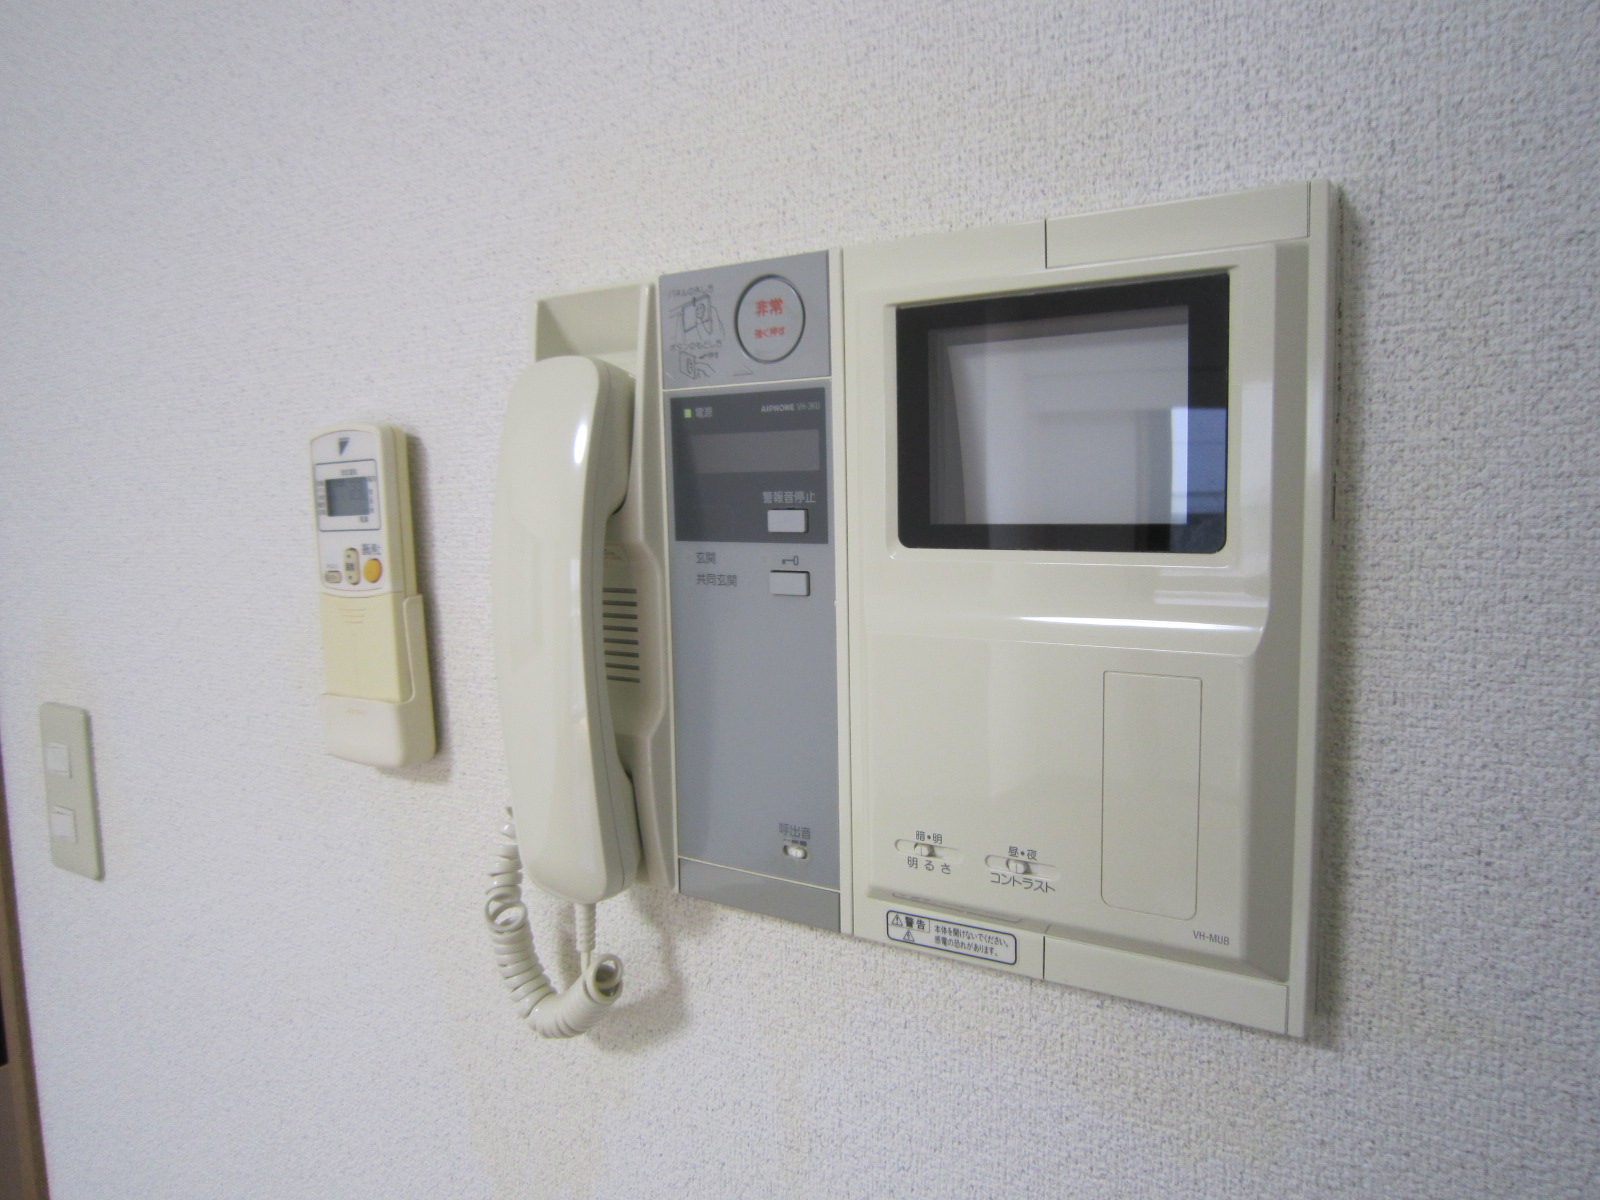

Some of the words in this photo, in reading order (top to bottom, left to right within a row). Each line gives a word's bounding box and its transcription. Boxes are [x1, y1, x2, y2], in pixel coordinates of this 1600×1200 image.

[755, 298, 783, 317] 非常
[695, 406, 713, 418] 電源
[761, 403, 795, 412] AIPHONE
[762, 491, 816, 504] 警報音停止
[696, 552, 717, 564] 玄関
[696, 573, 737, 587] 共同玄関
[779, 822, 811, 840] 呼出音
[990, 872, 1056, 894] コントラスト
[904, 915, 926, 931] 警告
